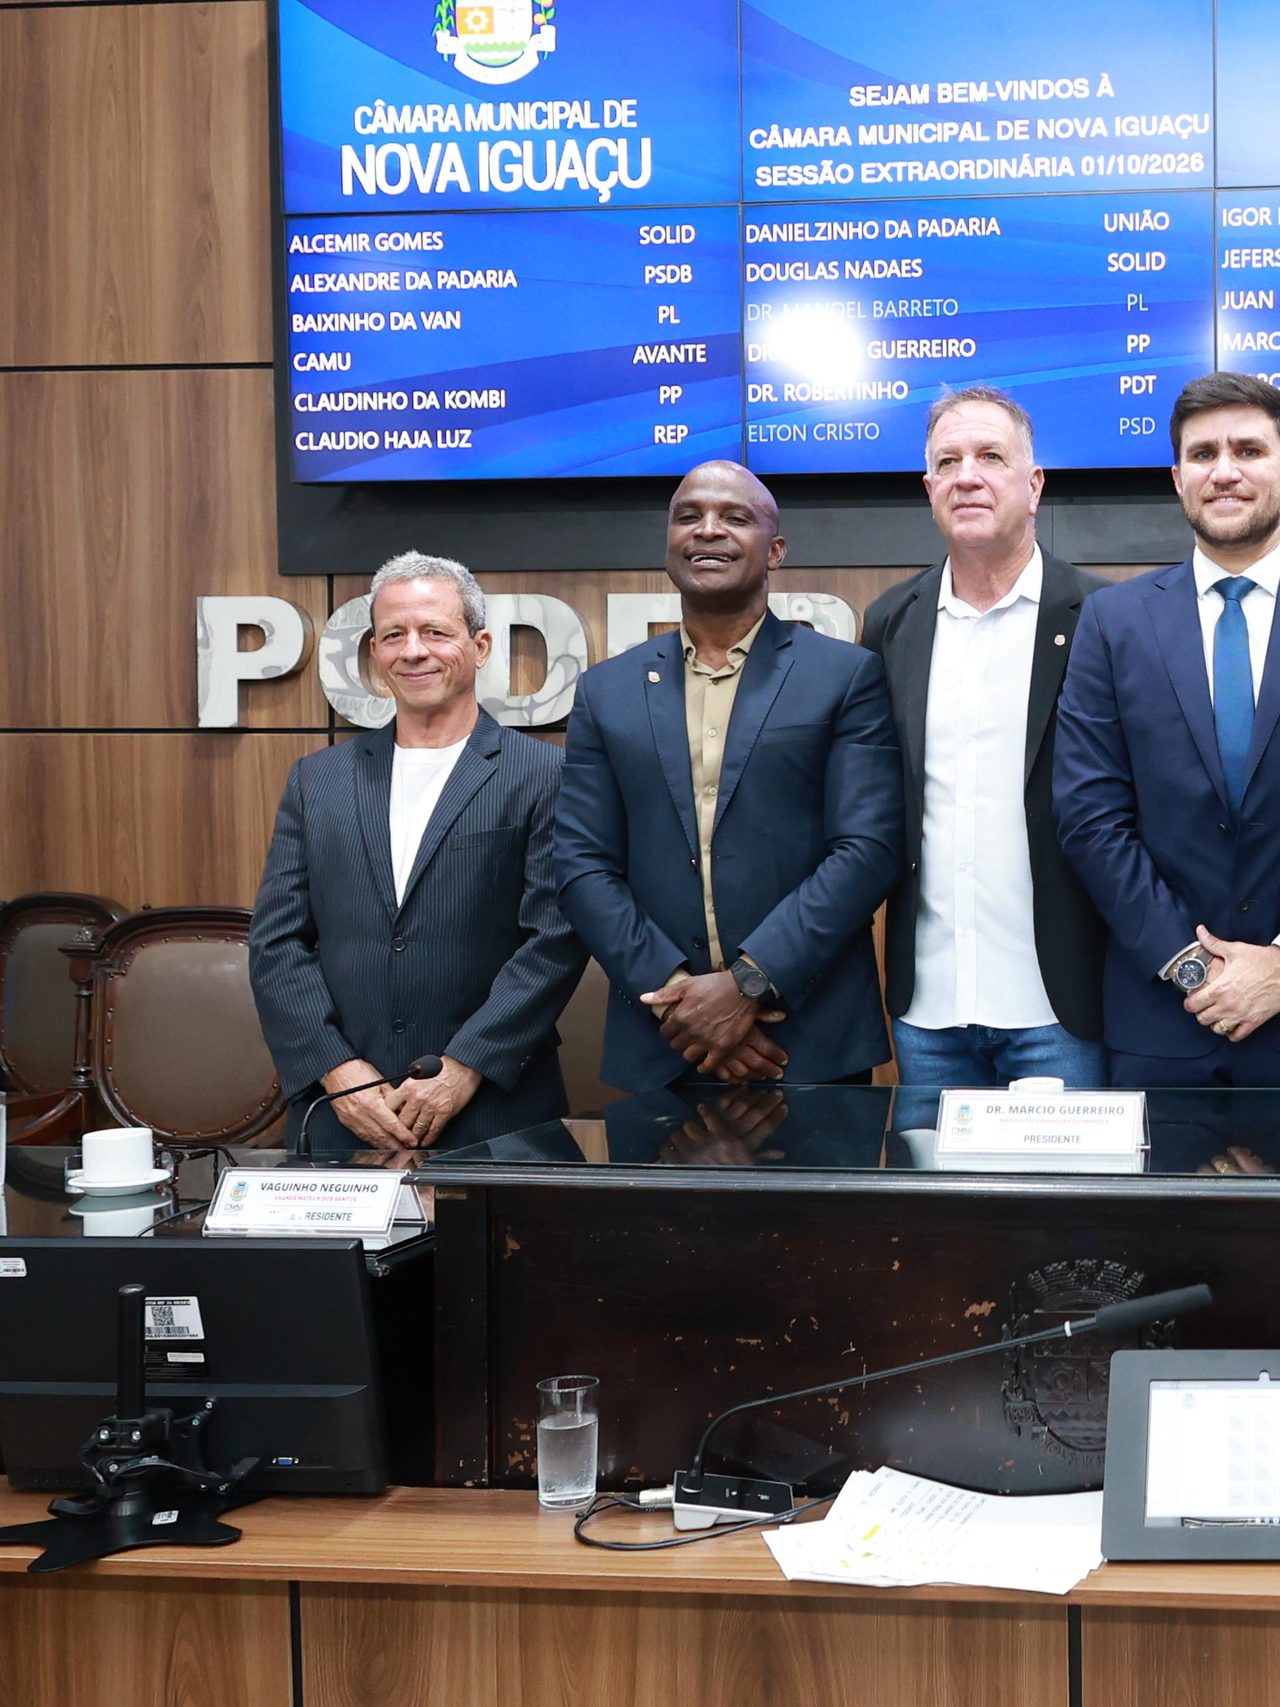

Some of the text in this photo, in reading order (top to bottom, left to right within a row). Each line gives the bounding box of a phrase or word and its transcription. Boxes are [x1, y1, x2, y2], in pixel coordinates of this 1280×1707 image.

[850, 73, 1114, 106] SEJAM BEM-VINDOS À
[355, 99, 637, 134] CÂMARA MUNICIPAL DE
[750, 114, 1209, 148] CÂMARA MUNICIPAL DE NOVA IGUAÇU
[342, 138, 651, 203] NOVA IGUAÇU
[756, 152, 1204, 186] SESSÃO EXTRAORDINÁRIA 01/10/2026
[1104, 209, 1169, 232] UNIÃO
[1223, 207, 1272, 226] IGOR
[640, 225, 695, 244] SOLID
[746, 217, 1000, 243] DANIELZINHO DA PADARIA
[290, 232, 443, 253] ALCEMIR GOMES
[747, 259, 922, 281] DOUGLAS NADAES
[1108, 252, 1165, 271] SOLID
[291, 270, 517, 292] ALEXANDRE DA PADARIA
[645, 265, 692, 283] PSDB
[872, 299, 959, 318] BARRETO
[1128, 294, 1148, 311] PL
[1222, 291, 1274, 310] JUAN
[293, 311, 460, 332] BAIXINHO DA VAN
[659, 306, 680, 323] PL
[867, 339, 976, 358] GUERREIRO
[1128, 334, 1150, 353] PP
[294, 353, 351, 371] CAMU
[633, 344, 706, 363] AVANTE
[748, 381, 908, 402] DR. ROBERTINHO
[1120, 375, 1156, 394] PDT
[295, 390, 505, 411] CLAUDINHO DA KOMBI
[660, 386, 682, 404] PP
[655, 425, 688, 443] REP
[749, 423, 879, 441] ELTON CRISTO
[1120, 417, 1155, 435] PSD
[296, 430, 472, 450] CLAUDIO HAJA LUZ
[986, 1106, 1124, 1115] DR. MARCIO GUERREIRO
[1024, 1135, 1081, 1143] PRESIDENTE
[260, 1183, 378, 1193] VAGUINHO NEGUINHO
[299, 1212, 352, 1221] RESIDENTE
